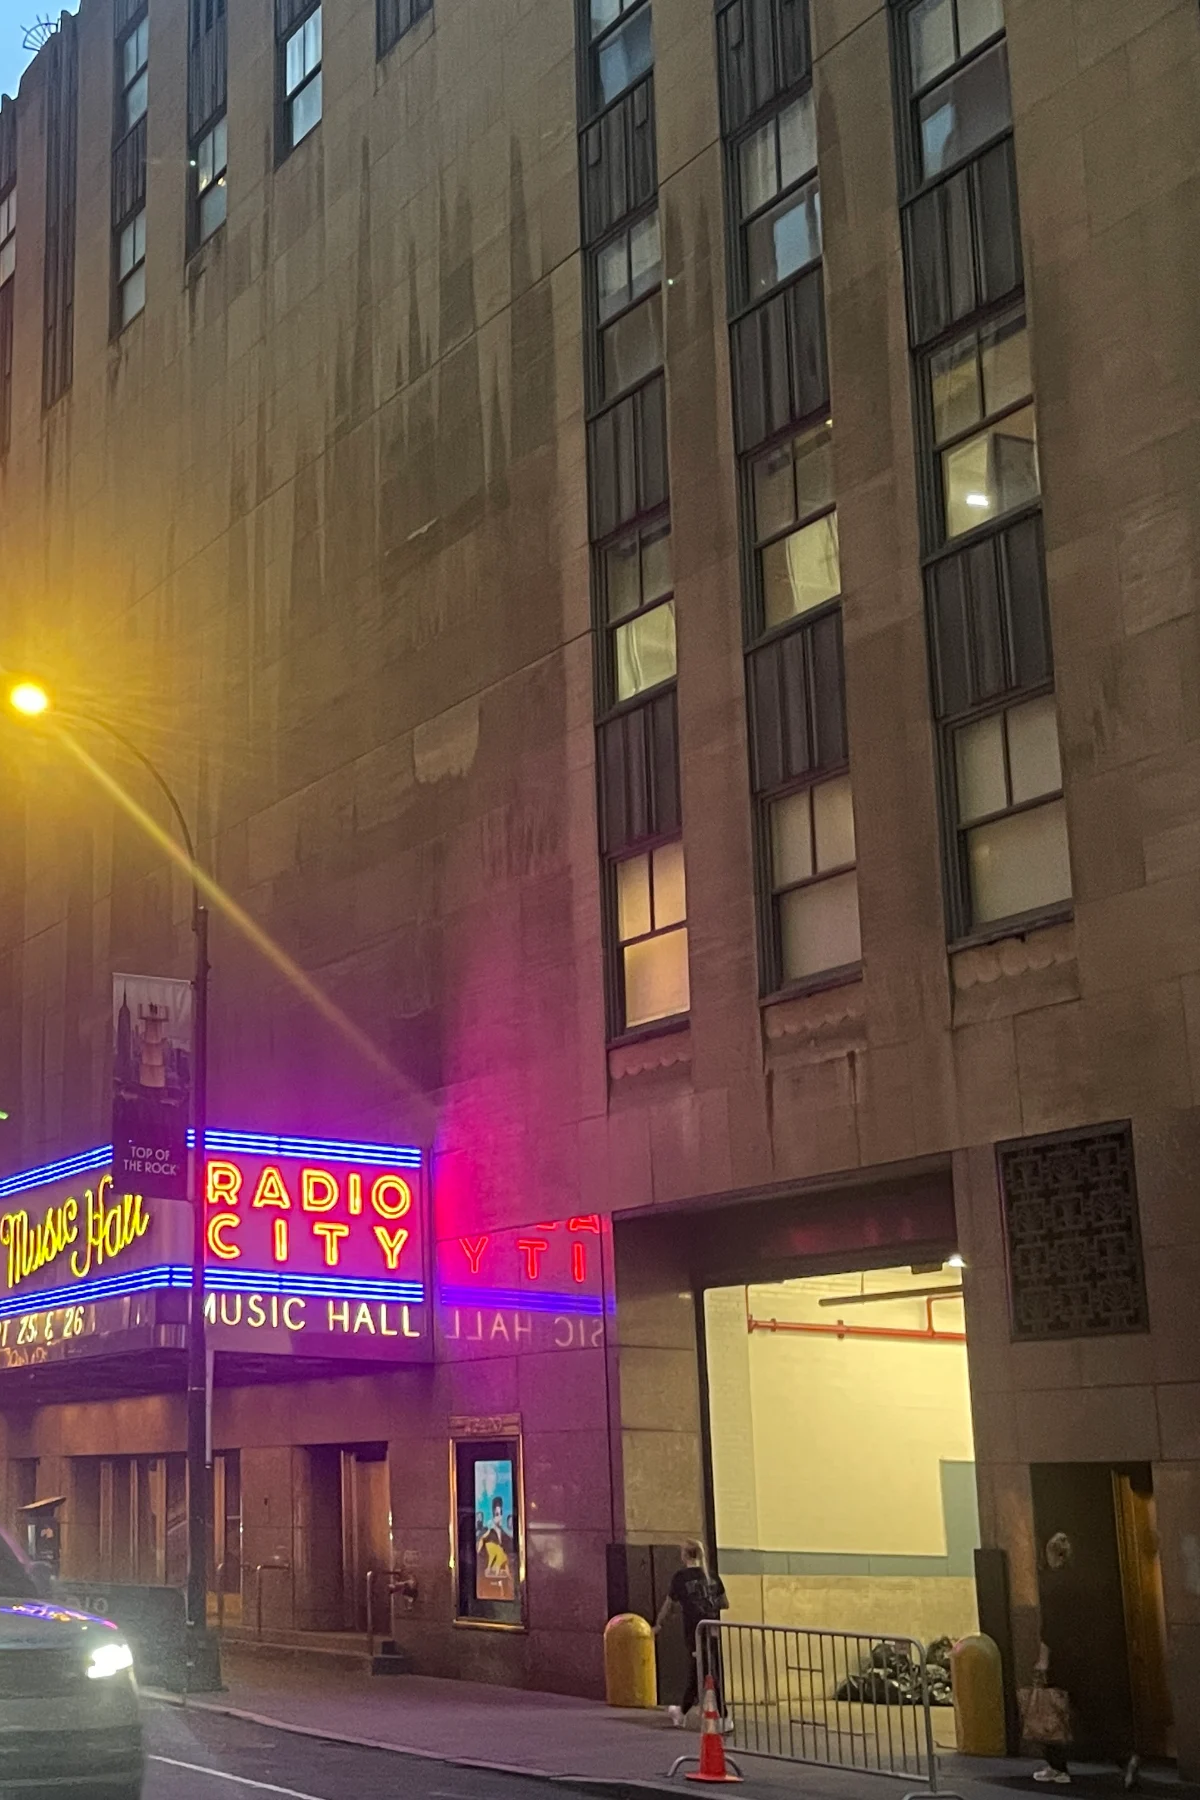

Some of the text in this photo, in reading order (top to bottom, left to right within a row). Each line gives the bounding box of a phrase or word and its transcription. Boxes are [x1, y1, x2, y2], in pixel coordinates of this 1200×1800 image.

[123, 1159, 177, 1176] THE ROCK
[131, 1146, 171, 1162] TOP OF
[207, 1160, 412, 1220] RADIO
[0, 1196, 79, 1289] Music
[71, 1174, 150, 1279] Hall
[207, 1213, 409, 1271] CITY
[17, 1313, 38, 1345] 25
[44, 1312, 54, 1346] &
[63, 1305, 85, 1338] 26
[327, 1301, 421, 1338] HALL
